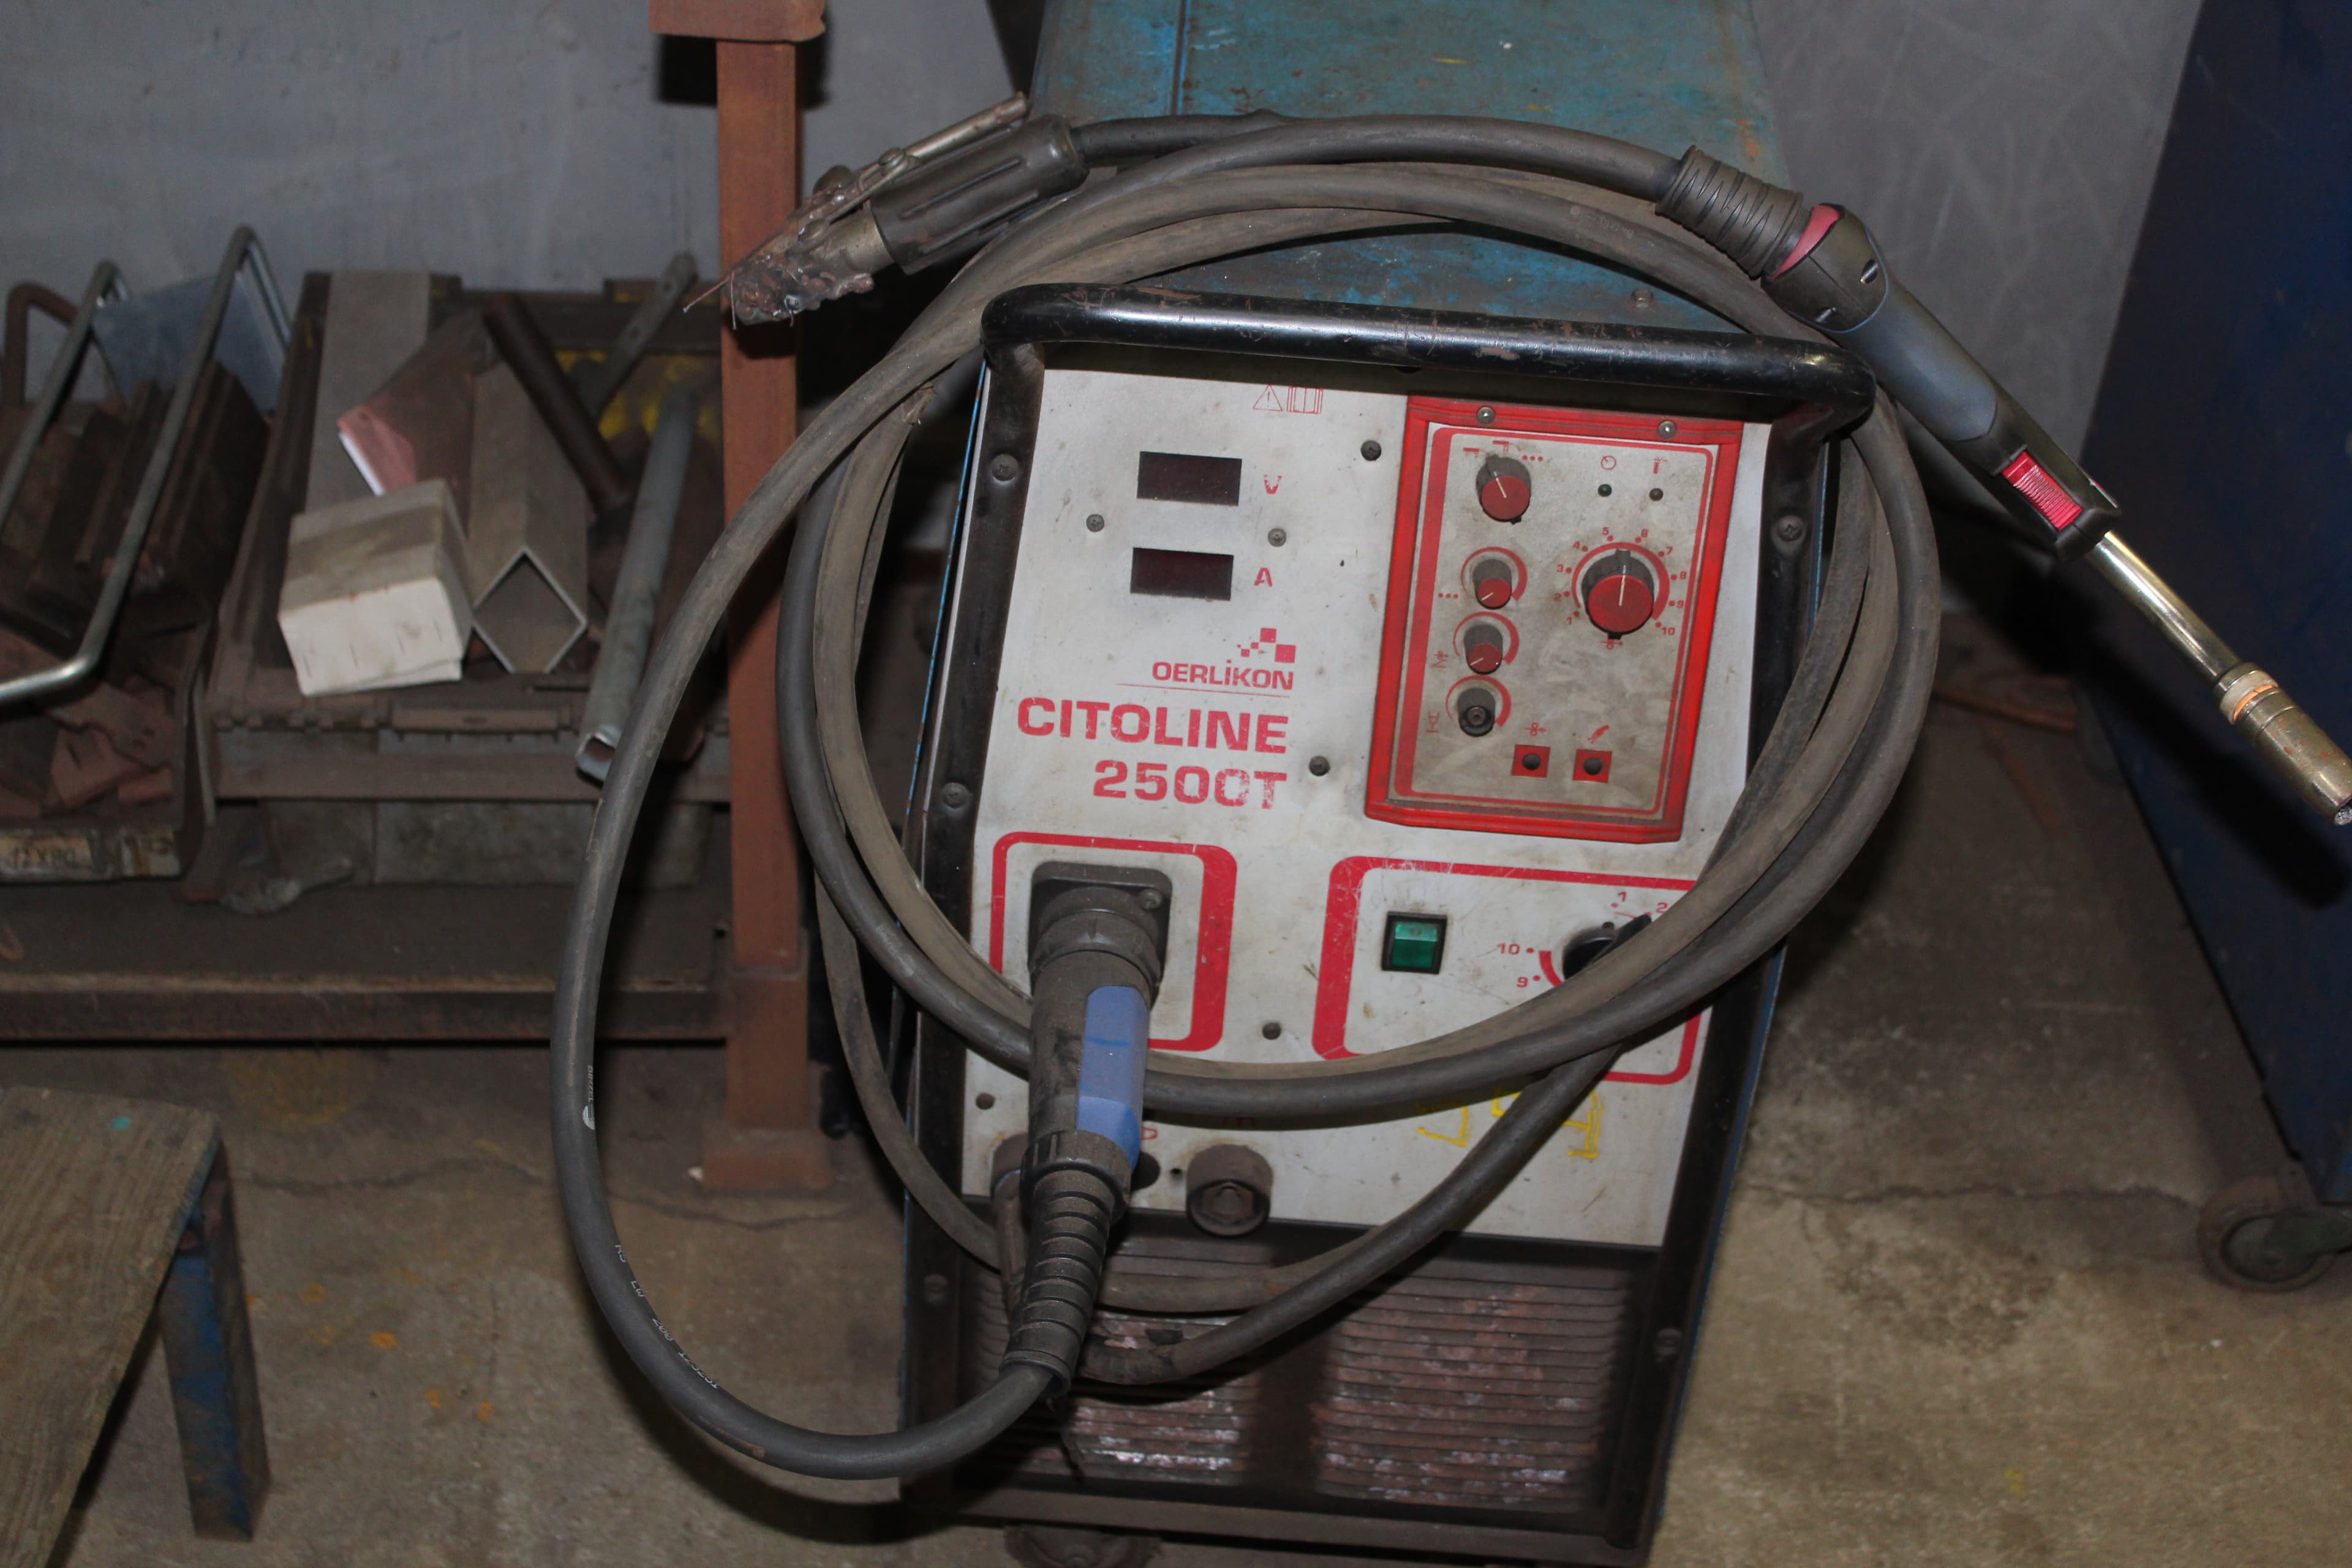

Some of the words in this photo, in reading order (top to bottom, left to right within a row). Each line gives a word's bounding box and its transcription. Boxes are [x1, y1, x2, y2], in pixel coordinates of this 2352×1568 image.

[1602, 527, 1610, 535] 5
[1641, 529, 1649, 538] 6
[1572, 541, 1581, 549] 4
[1665, 546, 1673, 555] 7
[1254, 568, 1273, 587] A
[1679, 571, 1687, 579] 8
[1554, 593, 1562, 601] 2
[1661, 627, 1676, 636] 10
[1017, 697, 1289, 754] CITOLINE
[1093, 760, 1287, 809] 250CT
[1617, 892, 1627, 902] 1
[1656, 902, 1668, 913] 2
[1498, 943, 1520, 955] 10
[1516, 977, 1529, 987] 9
